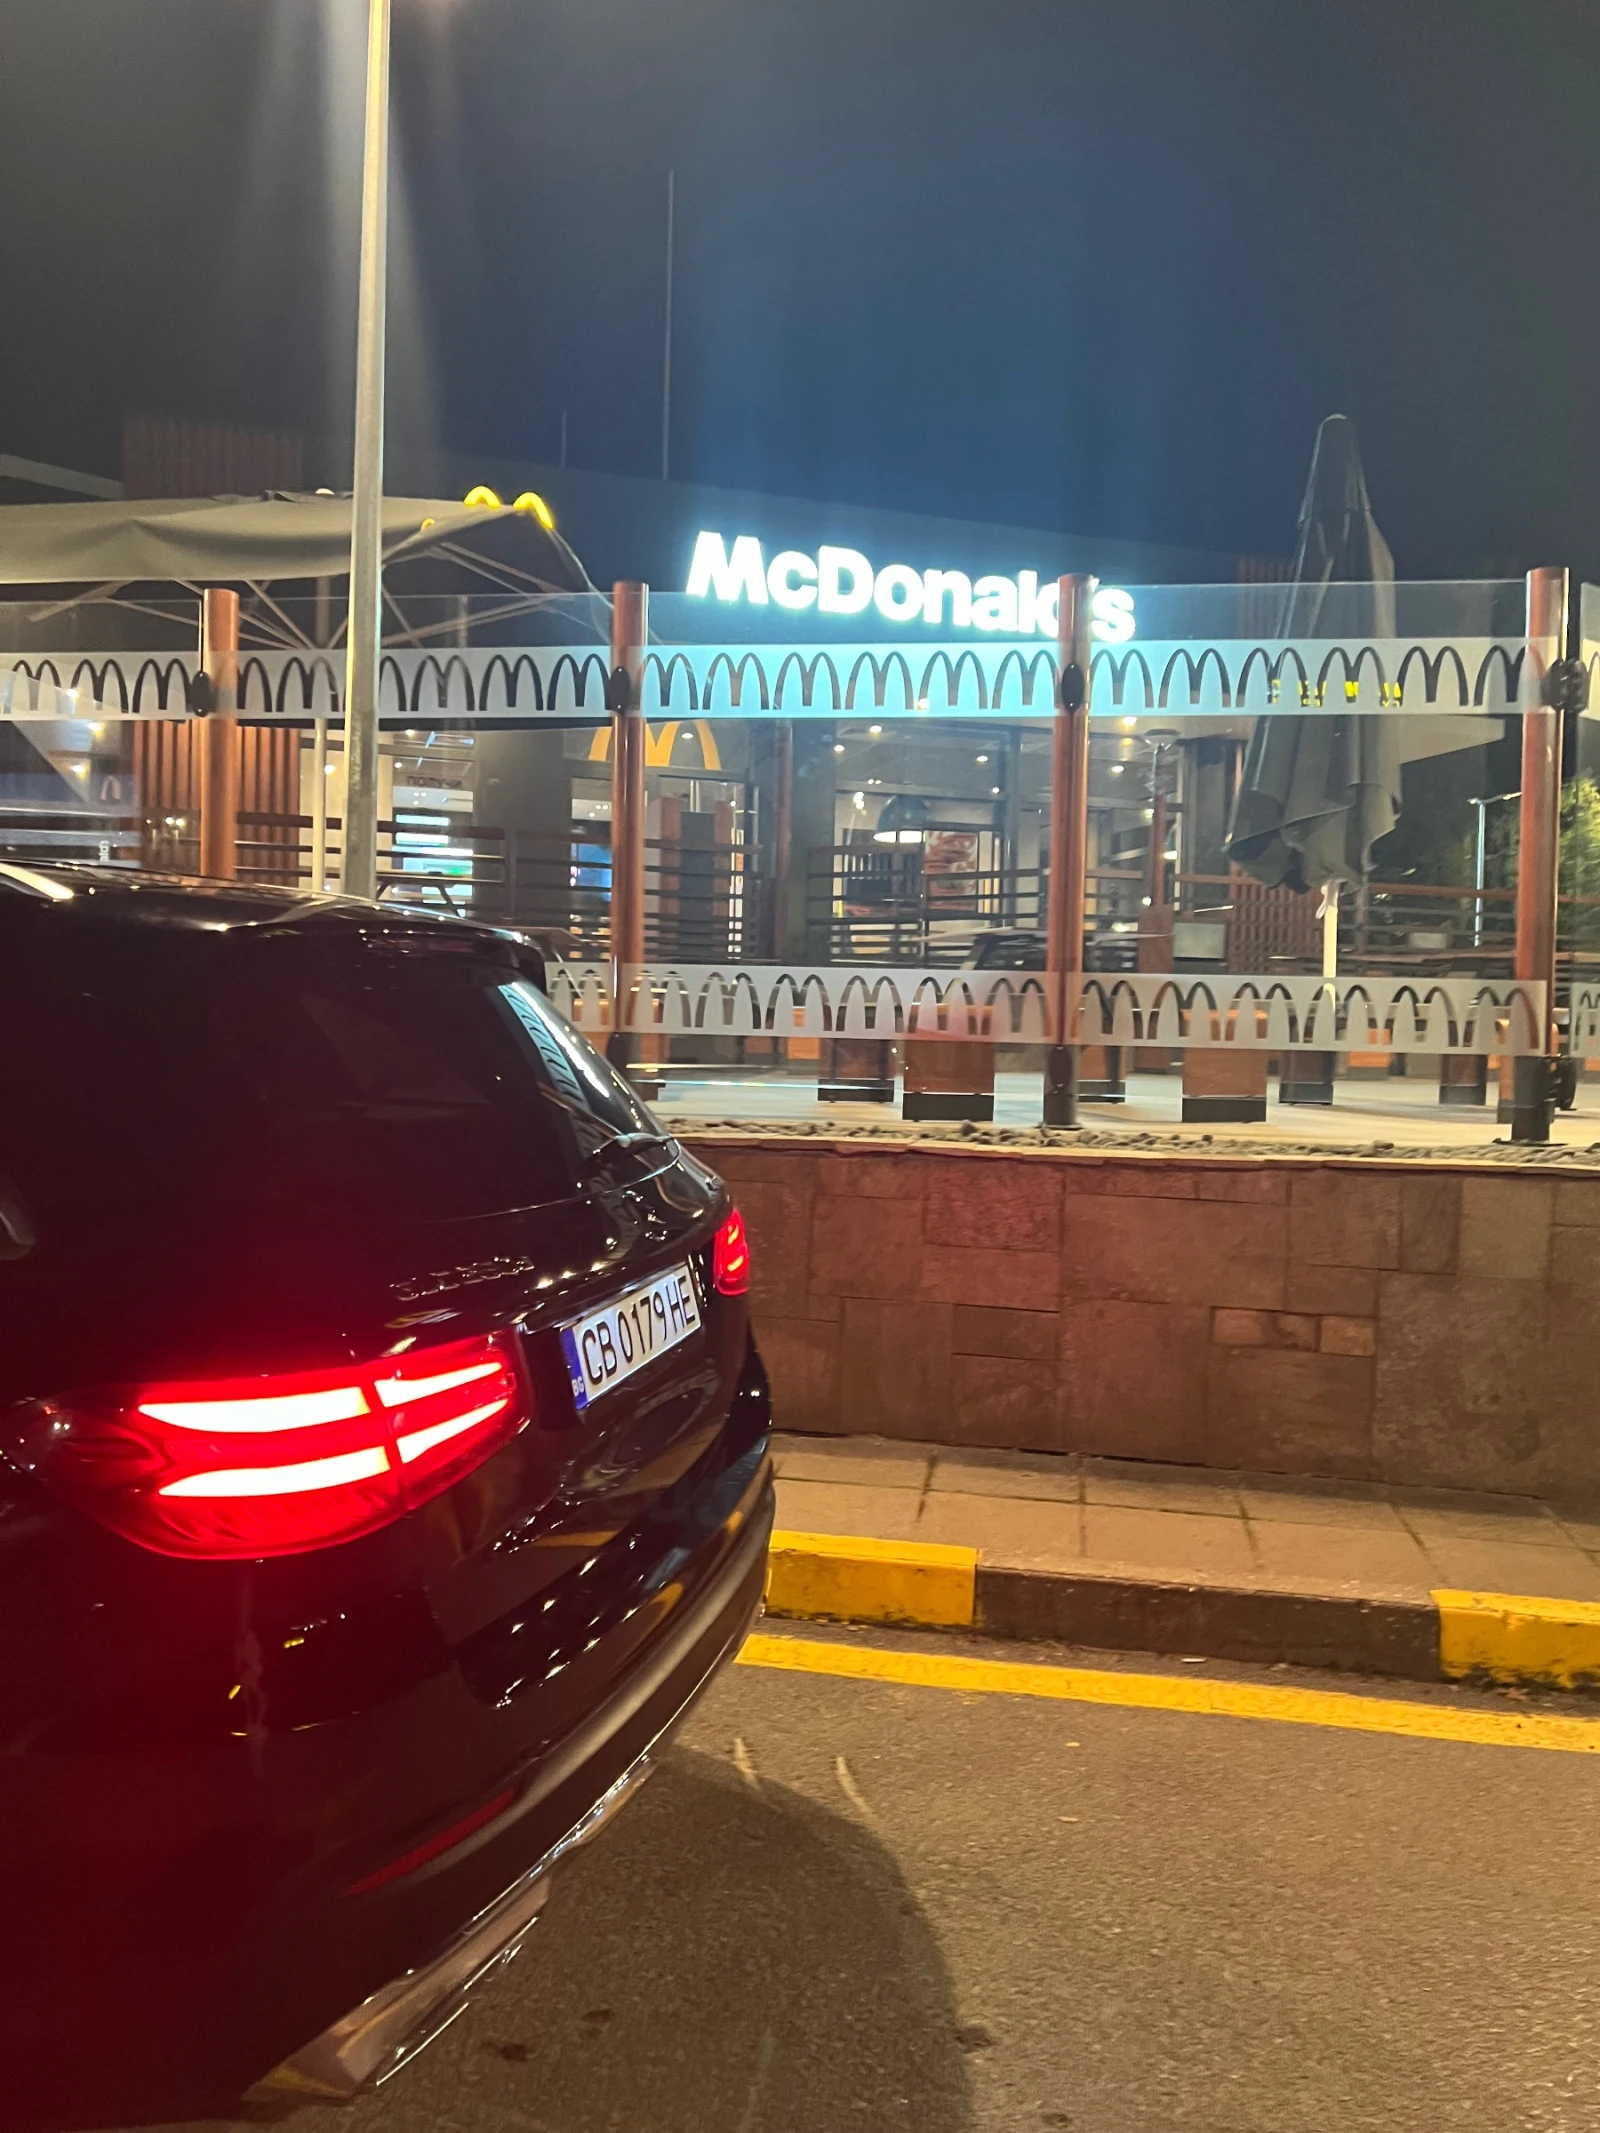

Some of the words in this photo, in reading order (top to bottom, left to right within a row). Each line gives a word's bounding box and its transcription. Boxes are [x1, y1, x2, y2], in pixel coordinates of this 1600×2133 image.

[582, 1321, 618, 1385] CB
[617, 1291, 667, 1364] 0179
[665, 1275, 696, 1334] HE
[571, 1376, 586, 1397] BG
